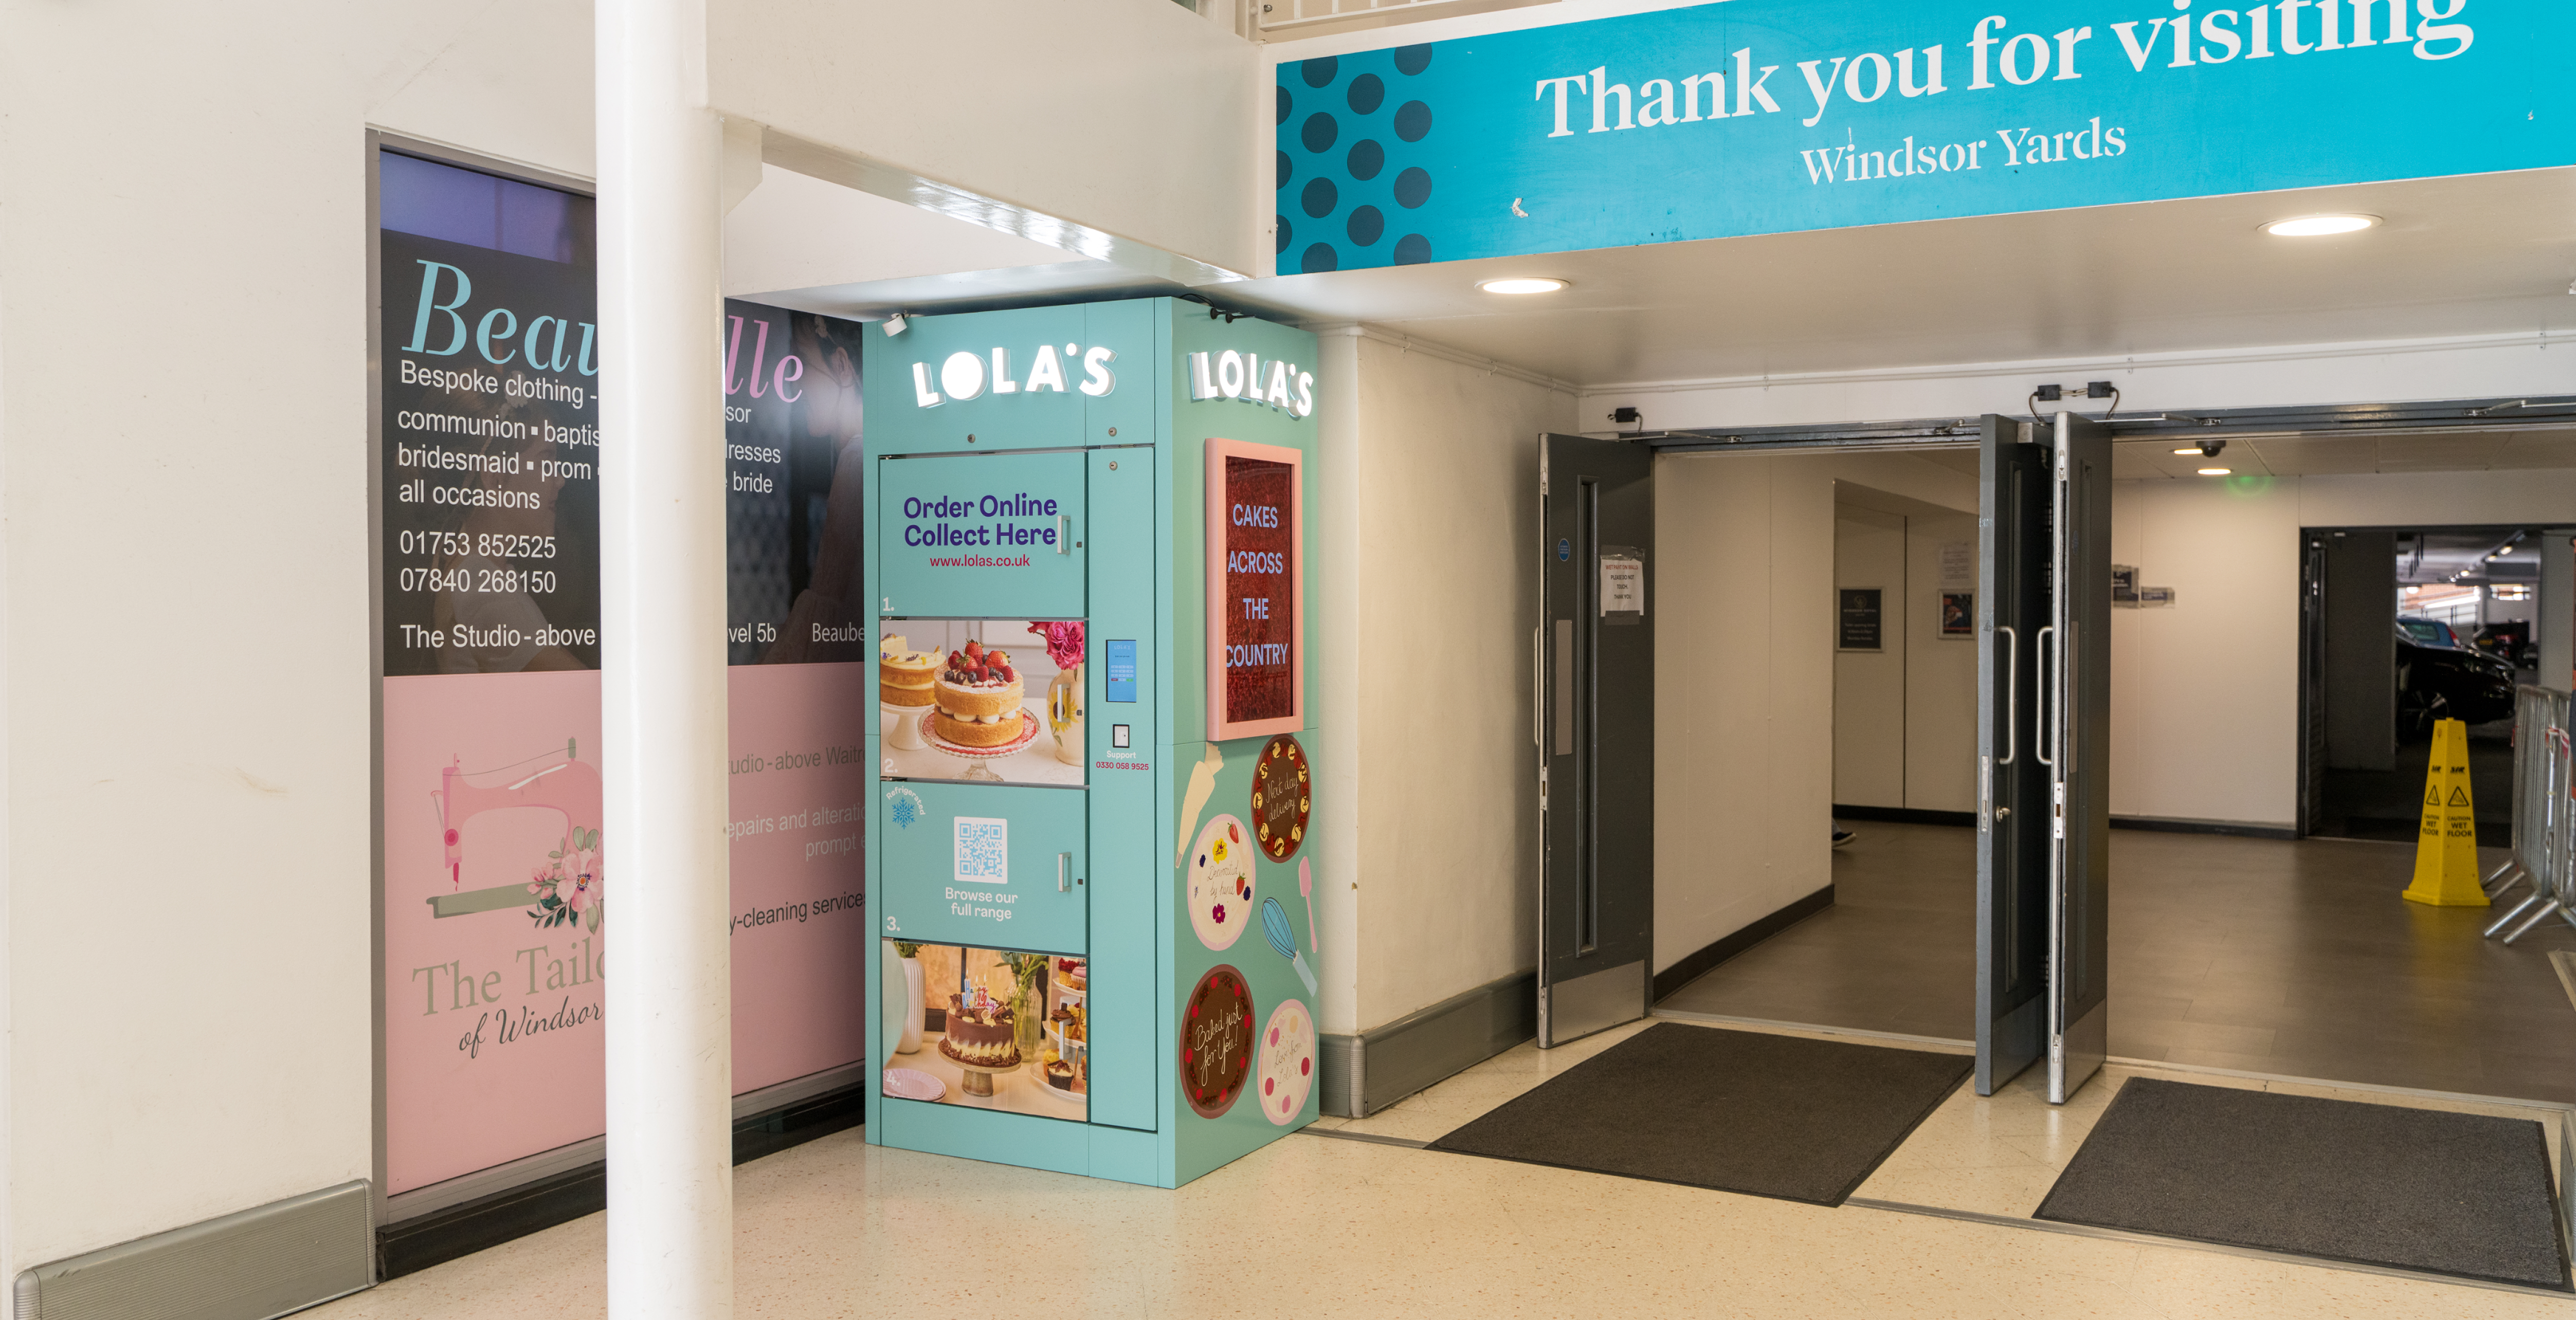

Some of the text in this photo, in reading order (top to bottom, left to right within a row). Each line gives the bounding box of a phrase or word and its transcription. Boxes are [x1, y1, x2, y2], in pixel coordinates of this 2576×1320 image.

[1536, 0, 2474, 137] Thank you for visiting
[1801, 117, 2126, 185] Windsor Yards
[401, 359, 498, 394] Bespoke
[505, 374, 584, 409] clothing
[913, 343, 1118, 409] LOLA'S
[1189, 350, 1314, 417] LOLA'S
[398, 410, 600, 450] communion baptis
[398, 442, 591, 482] bridesmaid prom
[399, 479, 540, 509] all occasions
[733, 471, 773, 493] bride
[904, 492, 1057, 519] Order Online
[1233, 503, 1278, 528] CAKES
[400, 530, 556, 559] 01753 852525
[904, 523, 1056, 546] Collect Here
[930, 554, 1030, 566] www.lolas.co.uk
[1227, 550, 1283, 574] ACROSS
[400, 567, 556, 593] 07840 268150
[883, 597, 895, 612] 1.
[1243, 598, 1269, 619] THE
[400, 624, 445, 648] The
[728, 622, 776, 643] vel 5b
[812, 621, 865, 642] Beaube
[1226, 643, 1289, 668] COUNTRY
[729, 754, 764, 776] udio
[884, 758, 898, 773] 2.
[1106, 750, 1136, 760] Support
[886, 785, 926, 815] Refrigerated
[1266, 772, 1299, 803] Next day
[1268, 797, 1296, 822] delivery
[728, 814, 774, 841] epairs
[779, 809, 807, 831] and
[2422, 828, 2439, 837] FLOOR
[806, 833, 857, 861] prompt
[945, 887, 1018, 904] Browse our
[730, 901, 807, 936] y-cleaning
[886, 915, 901, 932] 3.
[951, 903, 1012, 922] full range
[412, 959, 502, 1017] The
[459, 995, 604, 1059] of Windsor
[1194, 1009, 1225, 1051] Baked
[1200, 1045, 1217, 1087] for
[886, 1071, 901, 1087] 4.
